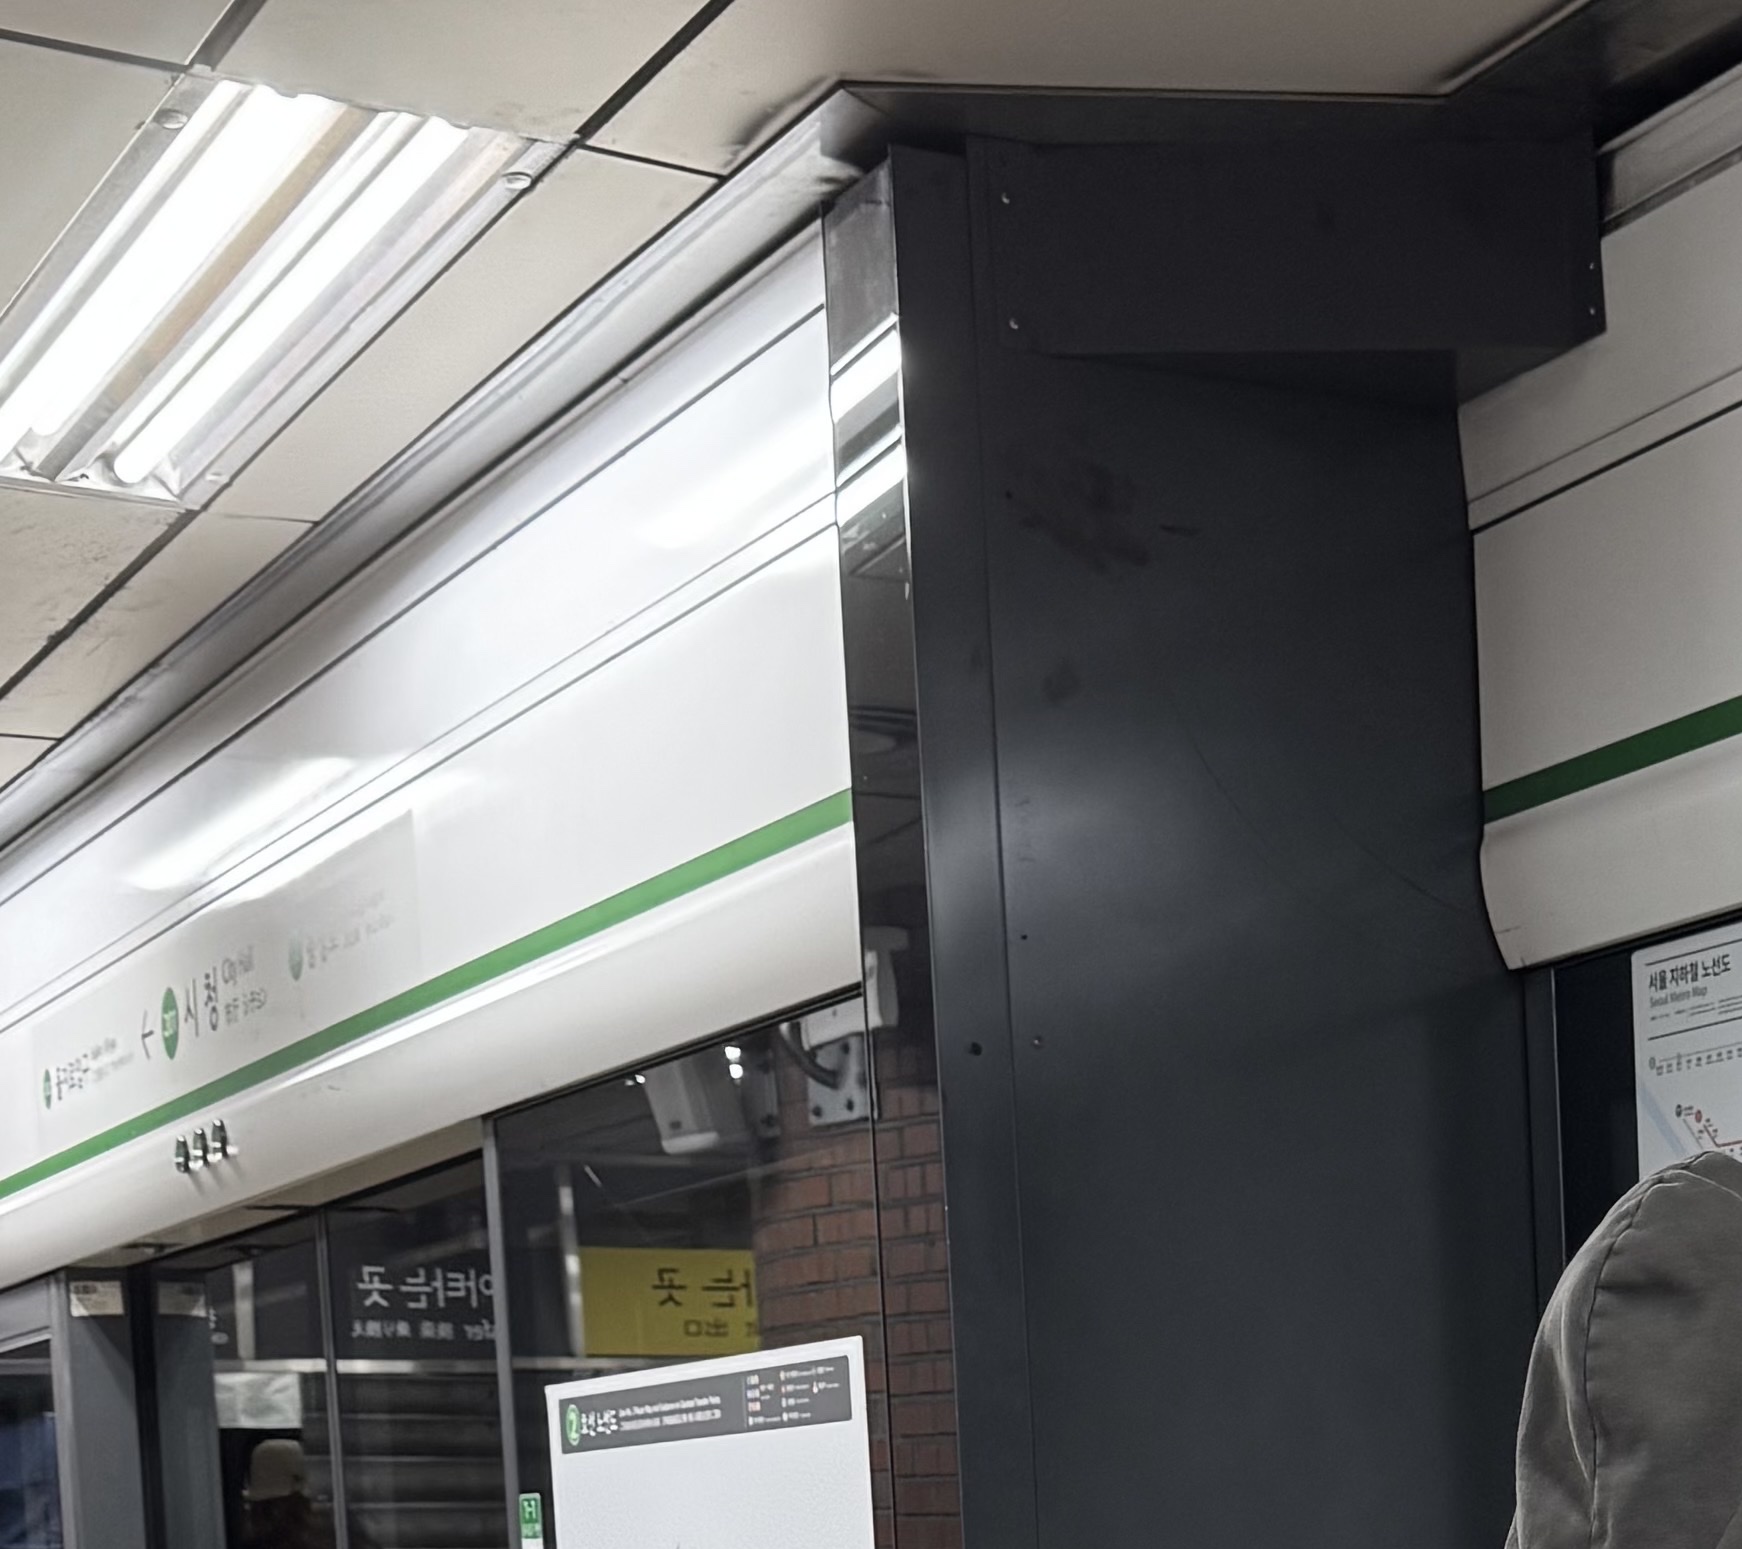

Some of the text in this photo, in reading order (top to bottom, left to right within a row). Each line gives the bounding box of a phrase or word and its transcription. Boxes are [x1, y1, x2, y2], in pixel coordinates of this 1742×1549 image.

[1649, 953, 1731, 992] 서울 지하철 노선도
